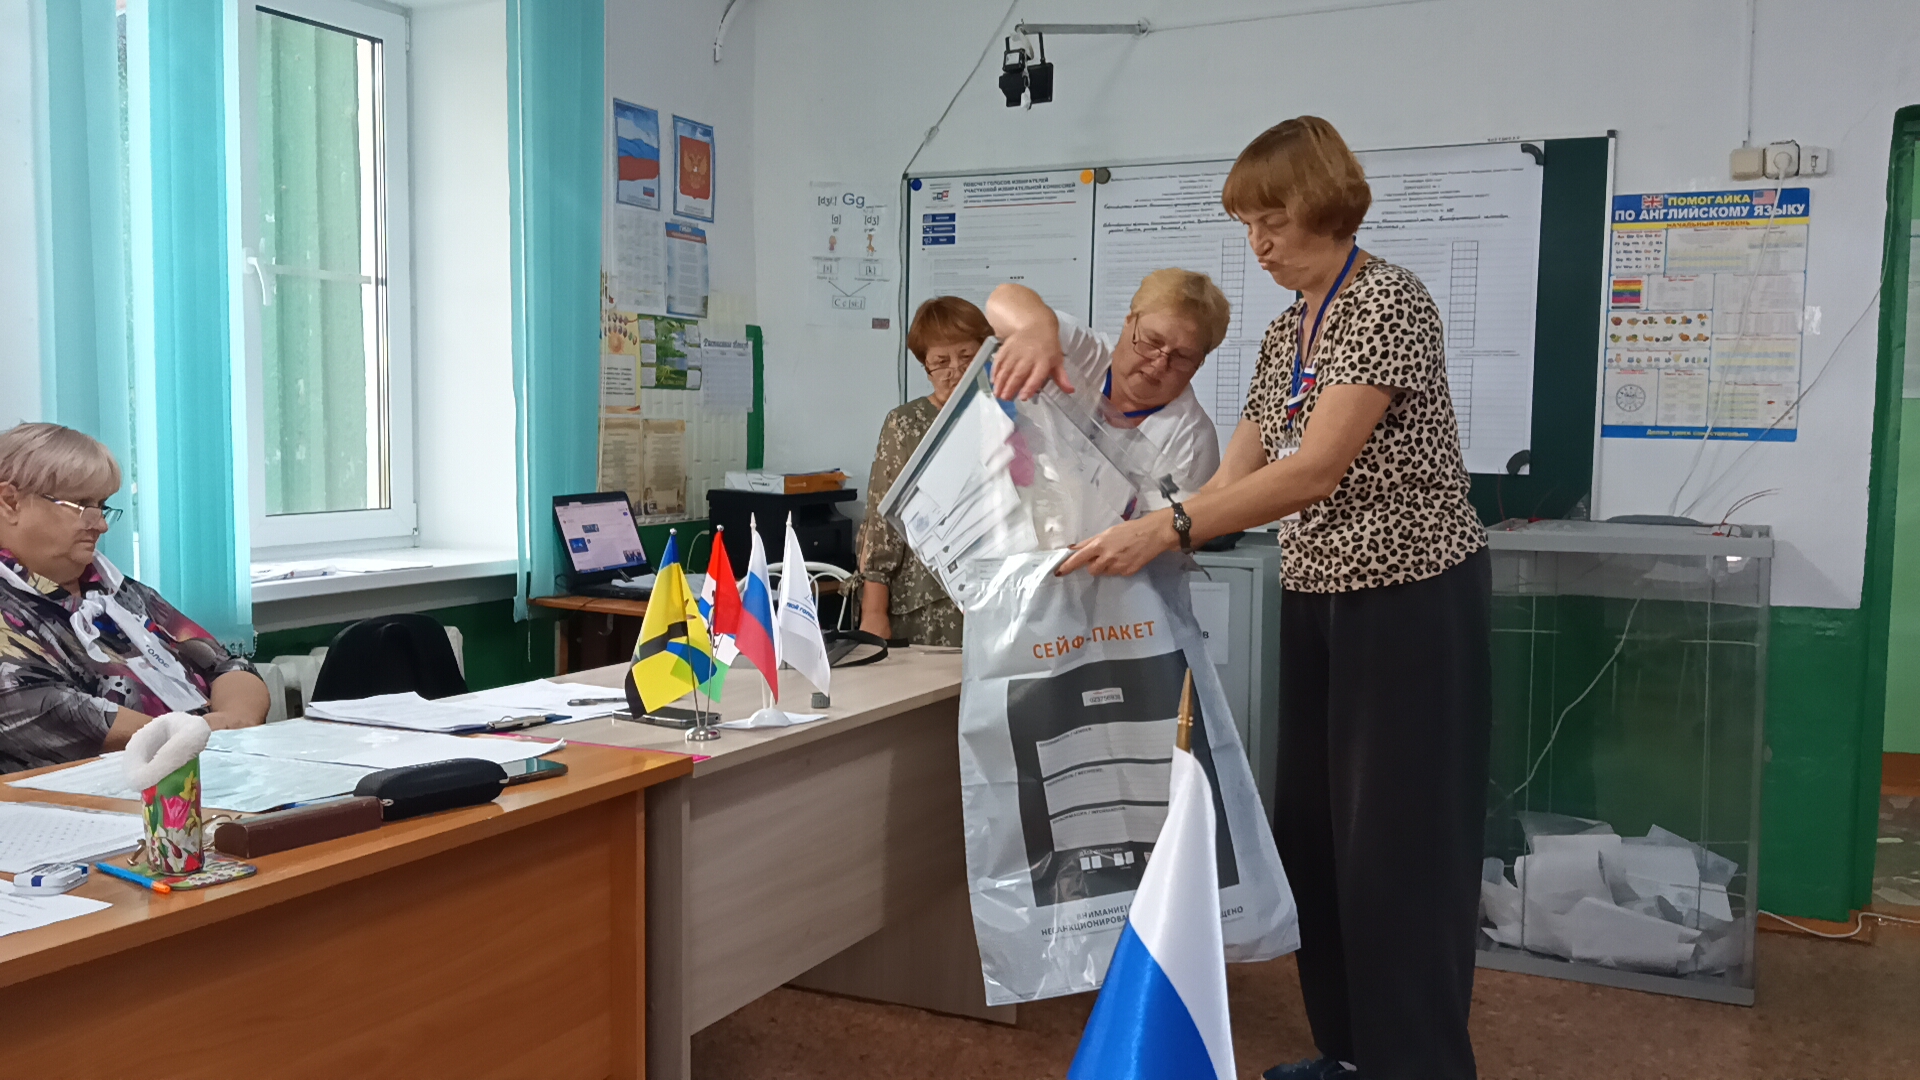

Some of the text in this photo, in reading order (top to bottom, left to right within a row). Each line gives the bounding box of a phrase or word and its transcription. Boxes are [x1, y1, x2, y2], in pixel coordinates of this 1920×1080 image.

[842, 192, 865, 209] Gg
[1667, 193, 1751, 206] ПОМОГАЙКА
[1615, 203, 1806, 221] ПО АНГЛИЙСКОМУ ЯЗЫКУ
[1667, 221, 1714, 229] НАЧАЛЬНЫЙ
[1032, 621, 1155, 659] СЕЙФ-ПАКЕТ
[1076, 904, 1129, 920] ВНИМАНИЕ!
[1041, 914, 1130, 936] НЕСАНКЦИОНИРОВА
